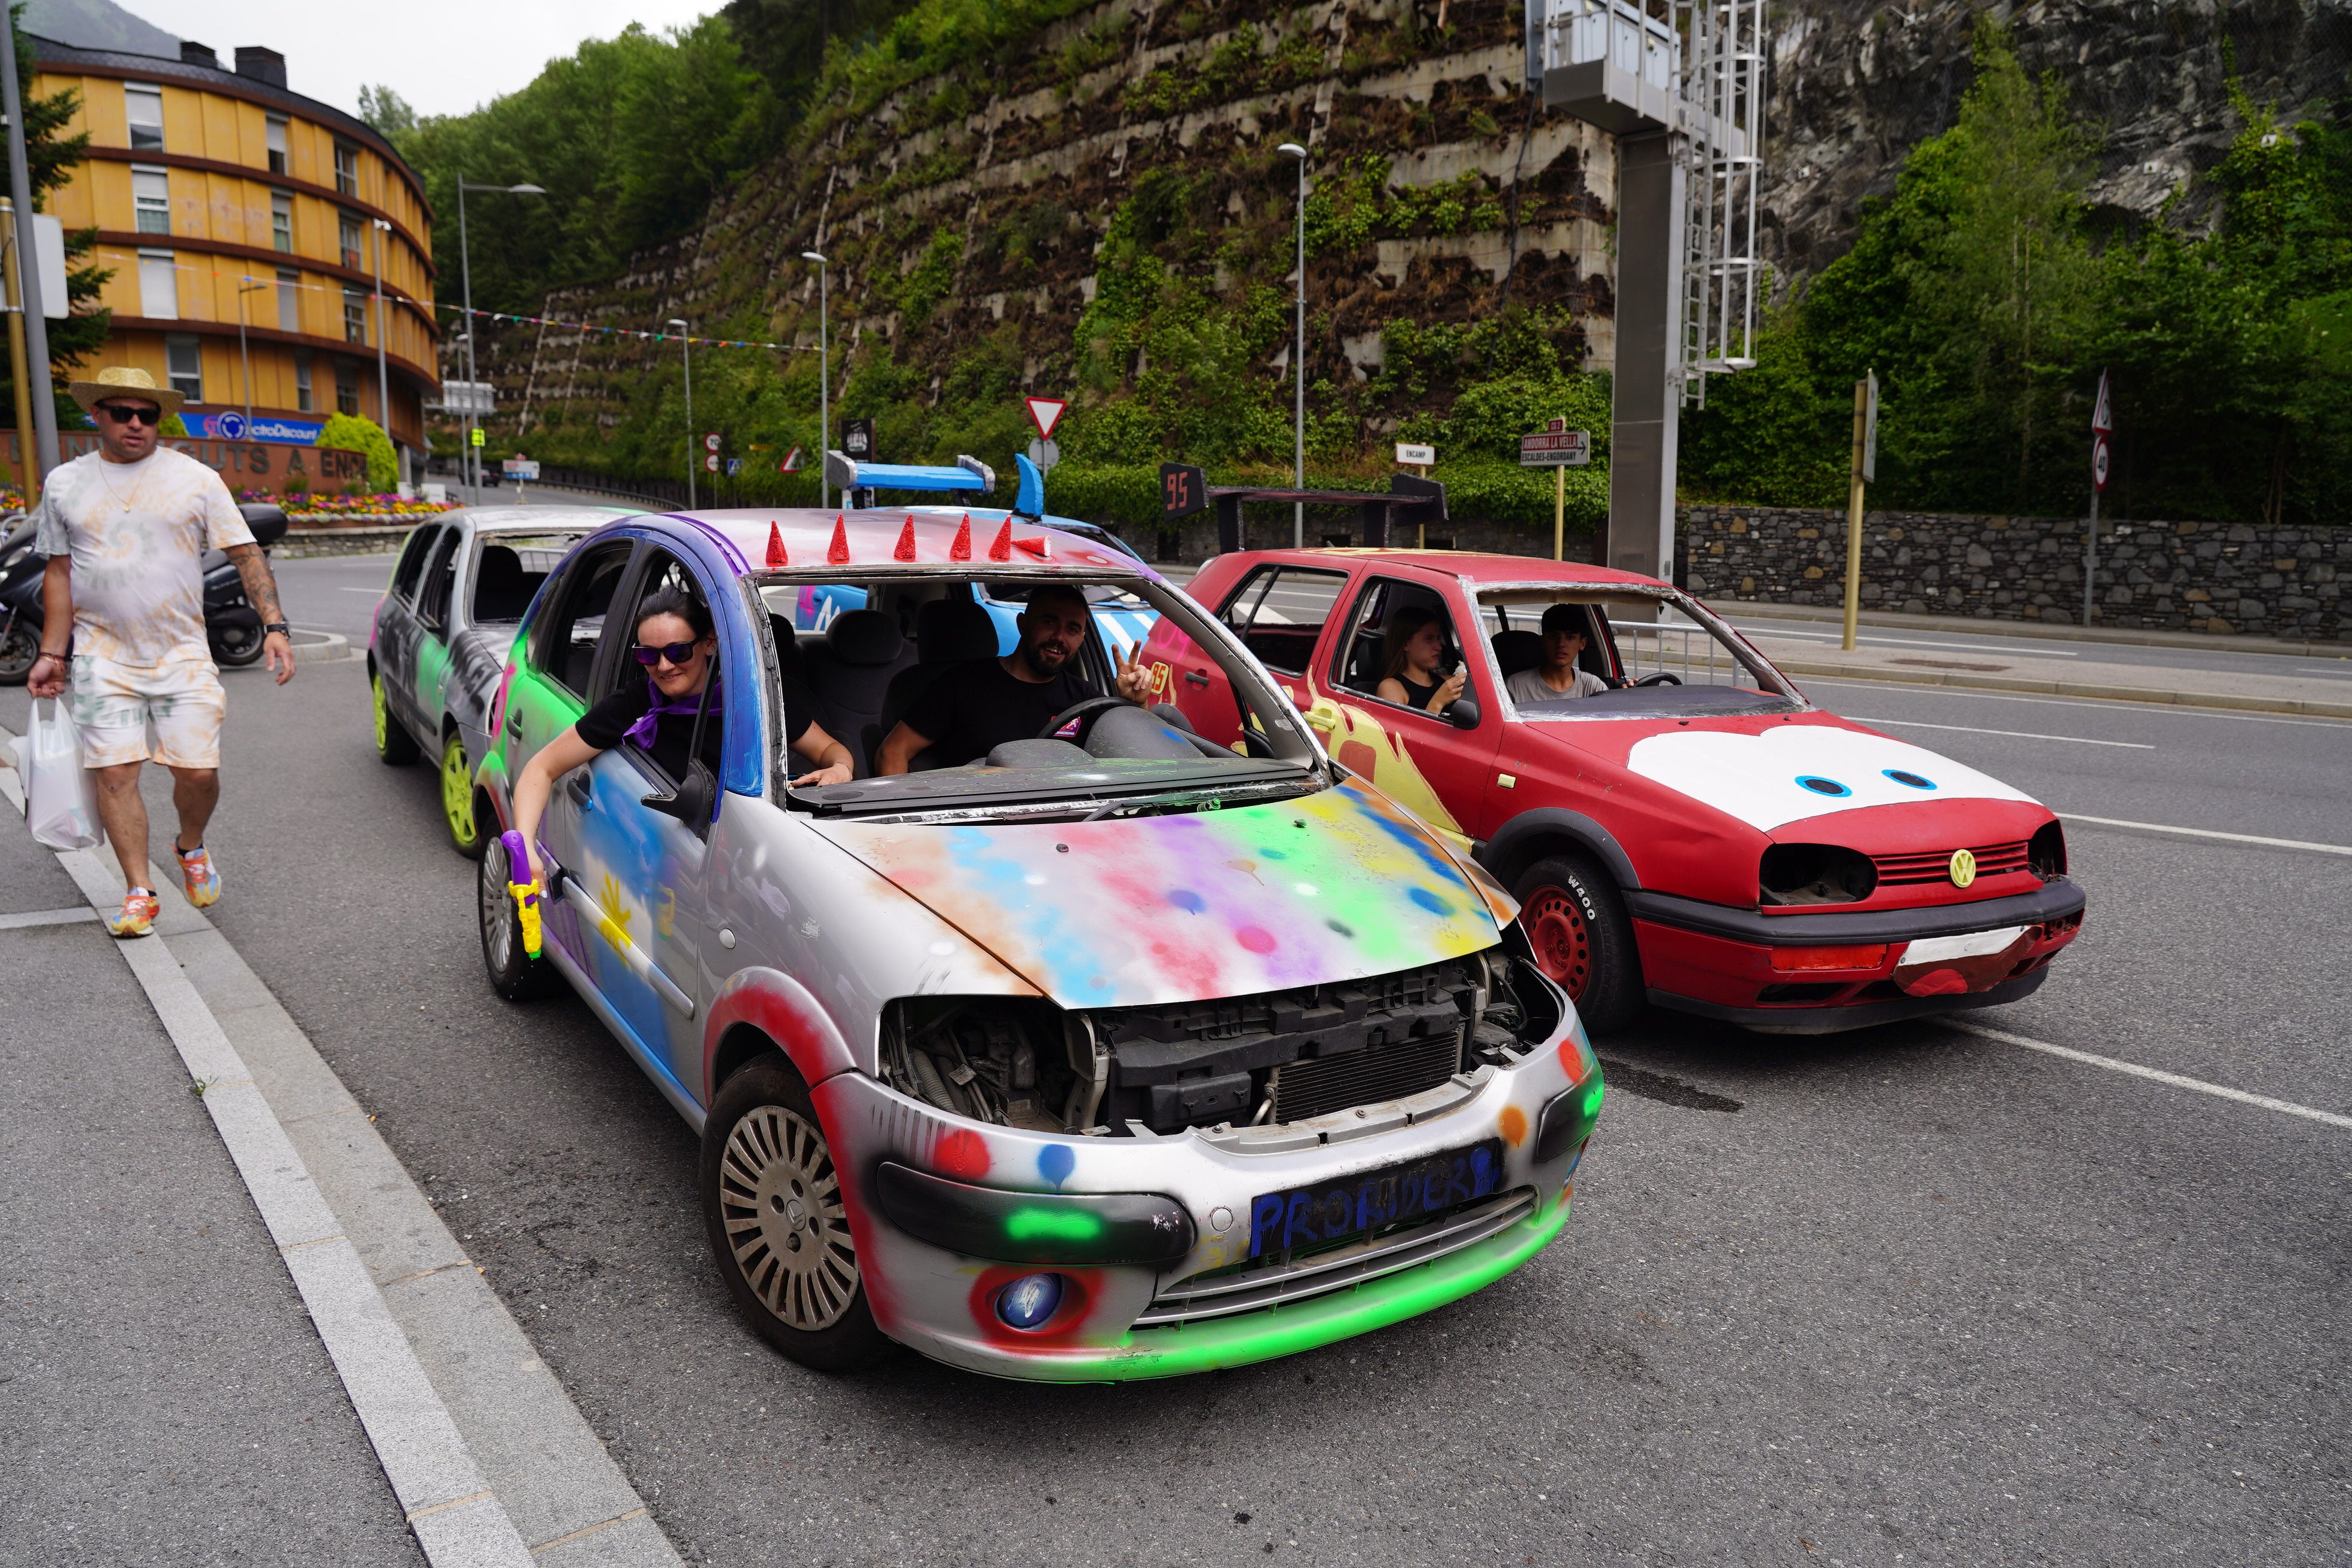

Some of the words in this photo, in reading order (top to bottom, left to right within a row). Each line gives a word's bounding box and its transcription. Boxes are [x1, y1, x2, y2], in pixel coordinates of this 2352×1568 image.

[1406, 449, 1426, 458] ENCAMP
[1523, 436, 1550, 450] ANDORRA
[1551, 436, 1559, 449] LA
[1560, 434, 1577, 448] VELLA
[288, 449, 305, 474] A
[1521, 452, 1576, 462] ESCALDES-ENGORDANY
[1167, 471, 1188, 510] 95
[1152, 663, 1166, 691] 95
[1568, 875, 1595, 920] W400
